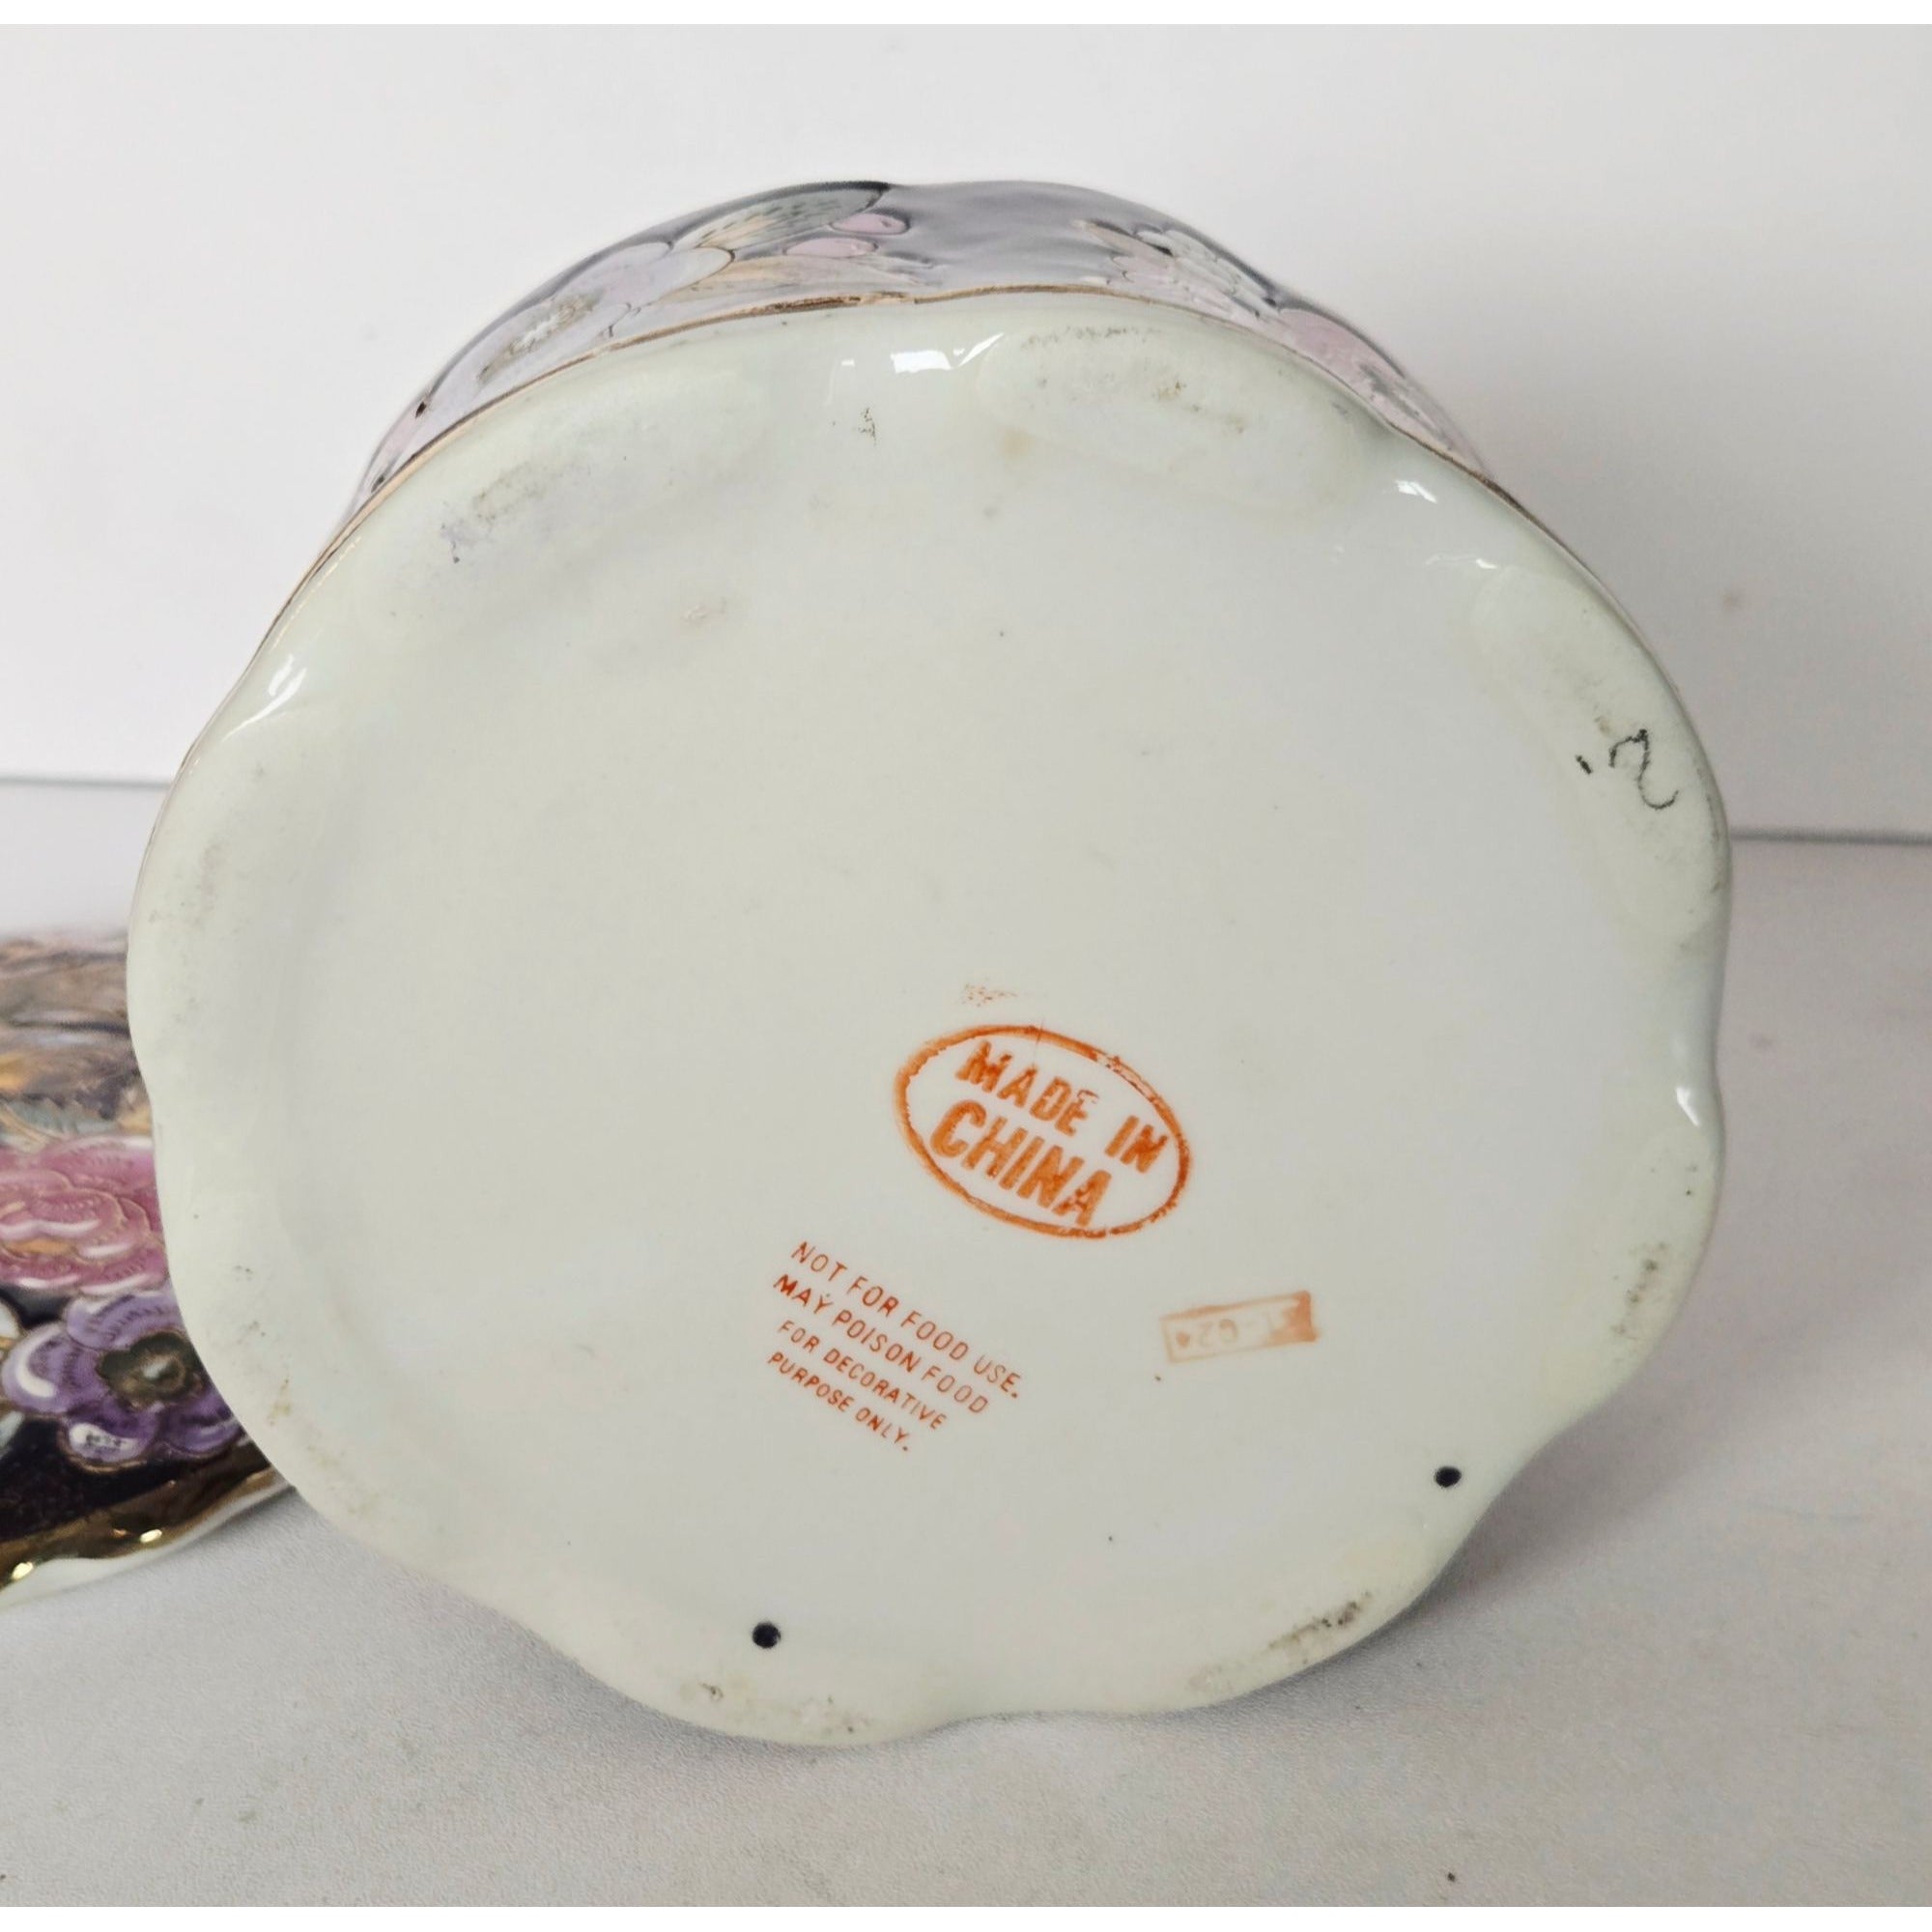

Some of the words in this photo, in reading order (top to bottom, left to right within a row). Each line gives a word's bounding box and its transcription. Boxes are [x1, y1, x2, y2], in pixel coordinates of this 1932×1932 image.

[929, 1099, 1112, 1228] CHINA
[954, 1039, 1099, 1137] MADE
[1104, 1115, 1168, 1174] IN
[772, 1273, 834, 1315] MAY
[831, 1309, 922, 1373] POISON
[921, 1365, 989, 1414] FOOD
[778, 1320, 820, 1353] FOR
[822, 1348, 948, 1431] DECORATIVE
[790, 1240, 848, 1282] NOT
[846, 1275, 899, 1318] FOR
[899, 1310, 970, 1361] FOOD
[973, 1354, 1022, 1400] USE.
[767, 1351, 855, 1413] PURPOSE
[855, 1406, 910, 1452] ONLY.
